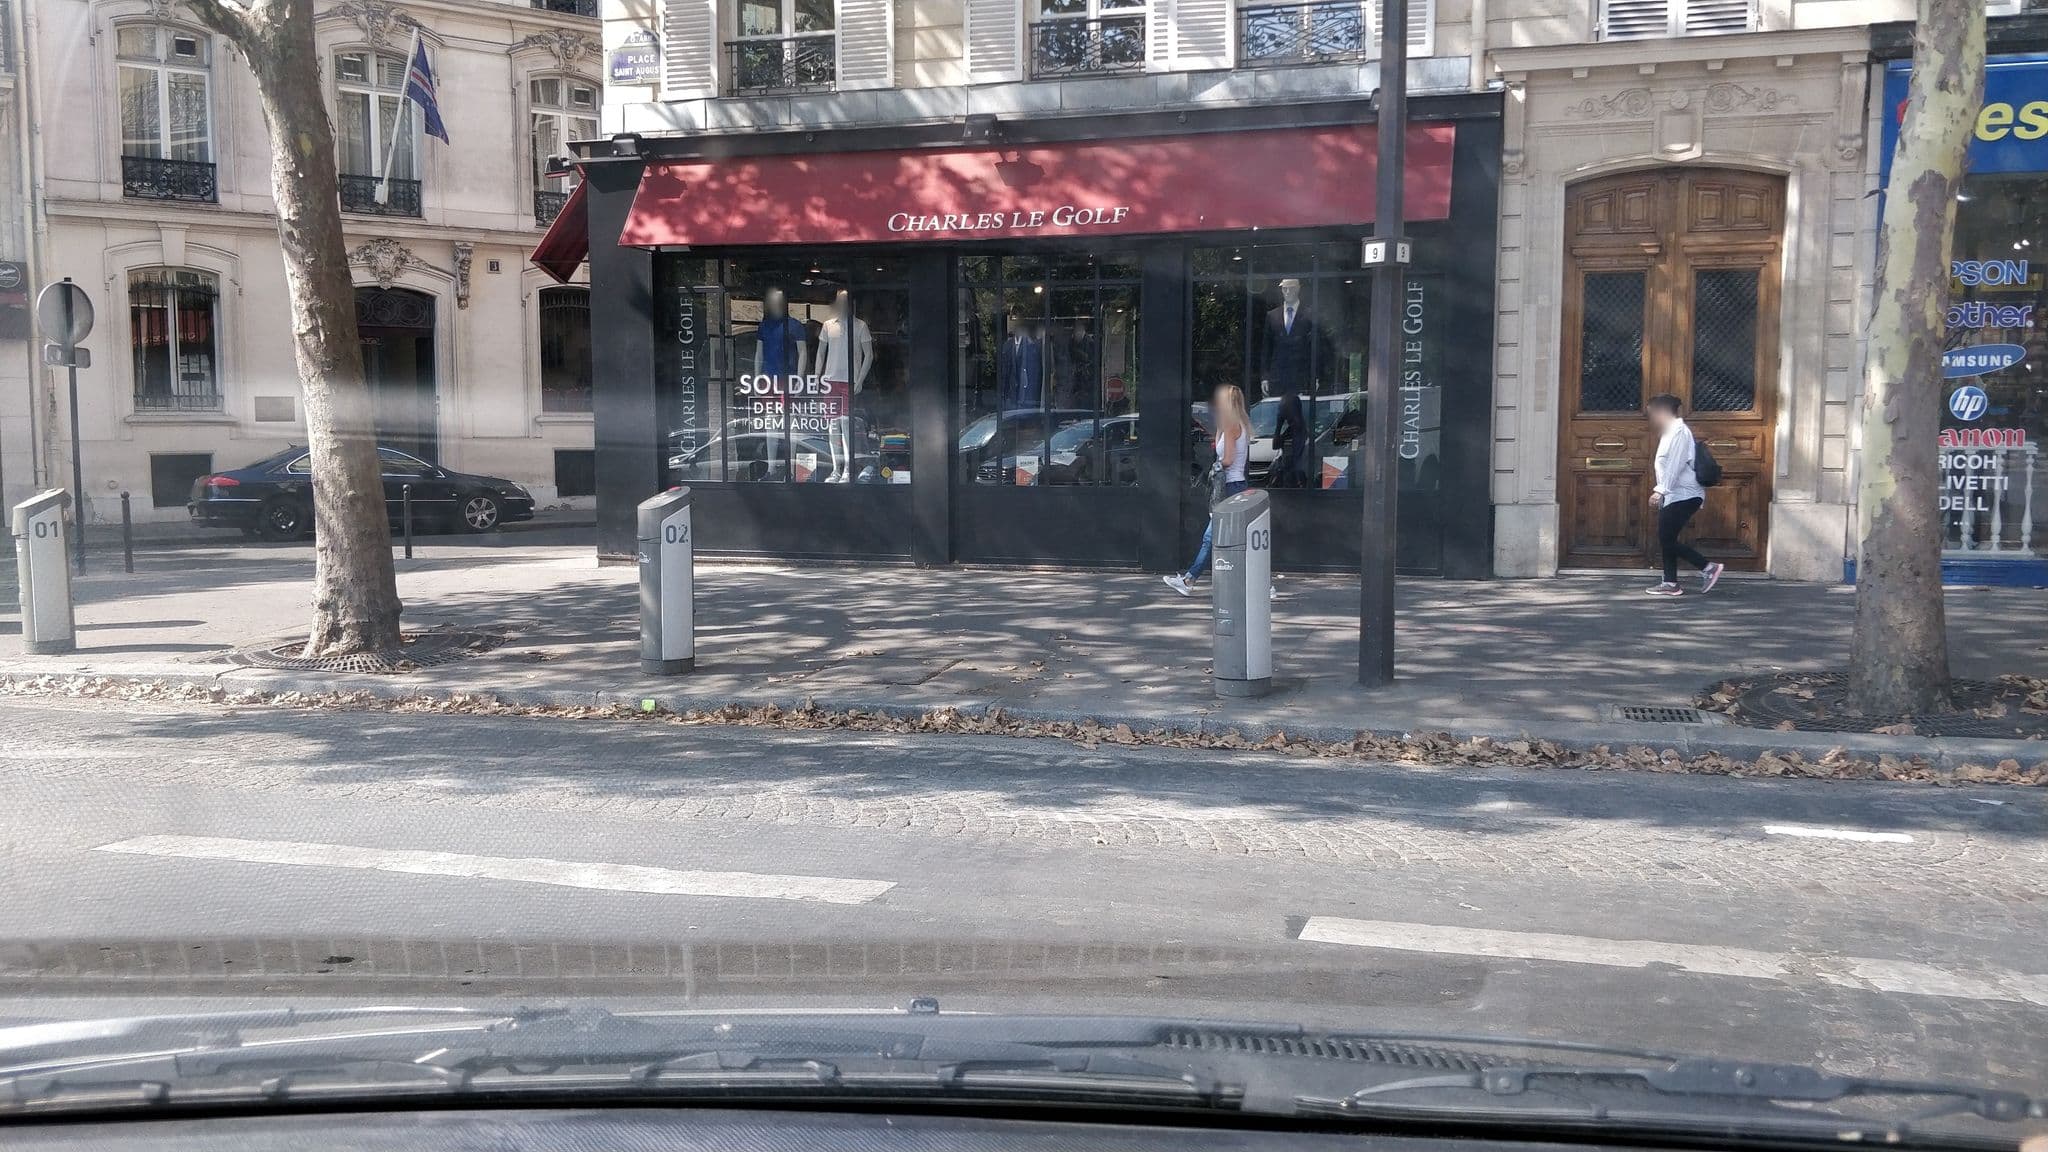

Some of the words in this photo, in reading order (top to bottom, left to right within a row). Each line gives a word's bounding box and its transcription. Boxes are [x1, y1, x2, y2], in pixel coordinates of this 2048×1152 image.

[628, 54, 656, 64] PLACE
[614, 67, 633, 76] SAINT
[636, 66, 659, 75] AUGUS
[888, 212, 1004, 232] CHARLES
[1010, 210, 1045, 228] LE
[1052, 206, 1129, 227] GOLF
[1951, 260, 2028, 285] PSON
[1403, 280, 1424, 334] GOLF
[1946, 302, 2033, 328] other
[682, 349, 694, 369] LE
[1406, 340, 1422, 364] LE
[1942, 355, 2012, 367] AMSUNG
[740, 374, 832, 395] SOLDES
[754, 399, 837, 415] DERNIÈRE
[1952, 386, 1984, 419] hp
[754, 416, 838, 432] DÉMARQUE
[1400, 371, 1421, 459] CHARLES
[1938, 428, 2026, 448] anon
[1938, 454, 1997, 470] RICOH
[1939, 496, 1989, 511] DELL
[35, 521, 58, 538] 01
[665, 524, 689, 544] 02
[1251, 529, 1269, 551] 03
